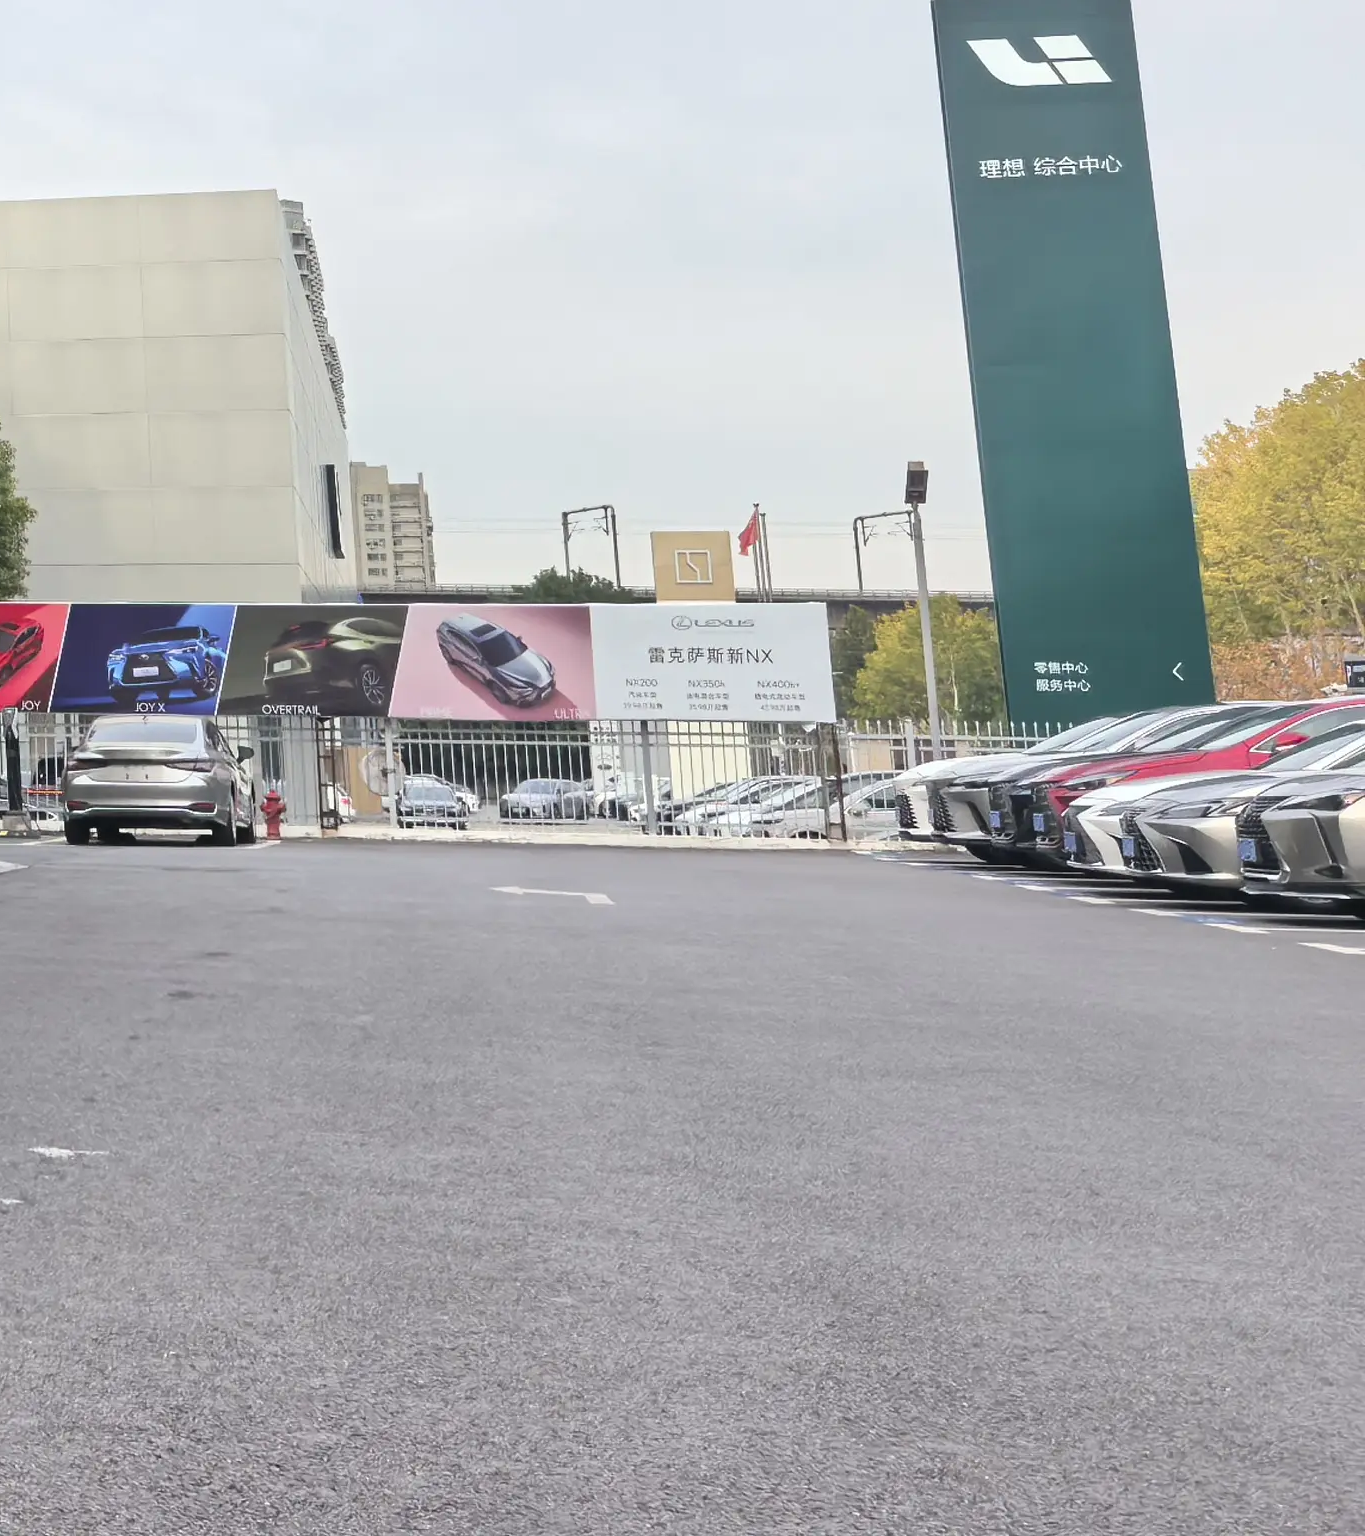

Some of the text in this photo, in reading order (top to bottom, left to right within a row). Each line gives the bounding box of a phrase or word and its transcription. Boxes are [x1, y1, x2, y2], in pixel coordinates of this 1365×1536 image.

[978, 154, 1123, 179] 理想 综合中心
[694, 618, 756, 628] LEXUS
[647, 646, 774, 665] 雷克萨斯新NX
[1033, 661, 1089, 674] 零售中心
[1036, 678, 1092, 692] 服务中心
[20, 700, 42, 711] JOY
[134, 702, 156, 713] JOY
[261, 704, 321, 716] OVERTRAIL
